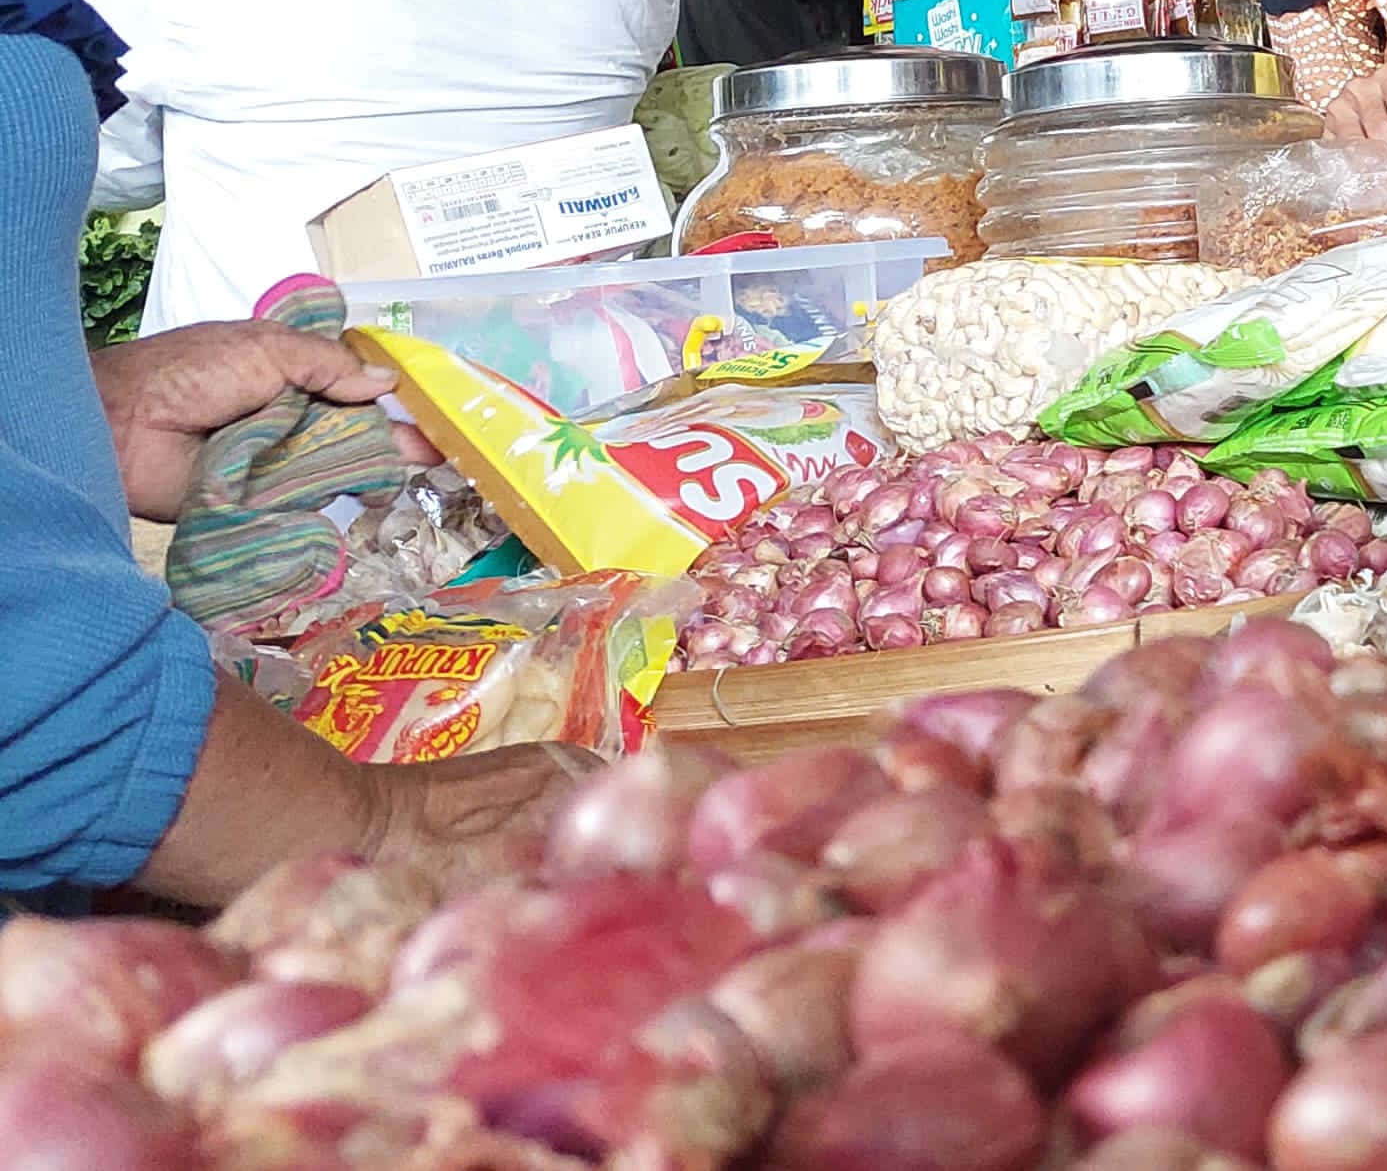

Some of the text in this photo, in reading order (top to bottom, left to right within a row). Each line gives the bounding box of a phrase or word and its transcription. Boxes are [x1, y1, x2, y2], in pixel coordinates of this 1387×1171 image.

[558, 185, 641, 216] RAJAWALI
[570, 220, 647, 244] KERUPUK BERAS
[476, 248, 504, 261] Beras
[504, 240, 543, 256] Kerupuk
[358, 642, 497, 681] KRUPUK
